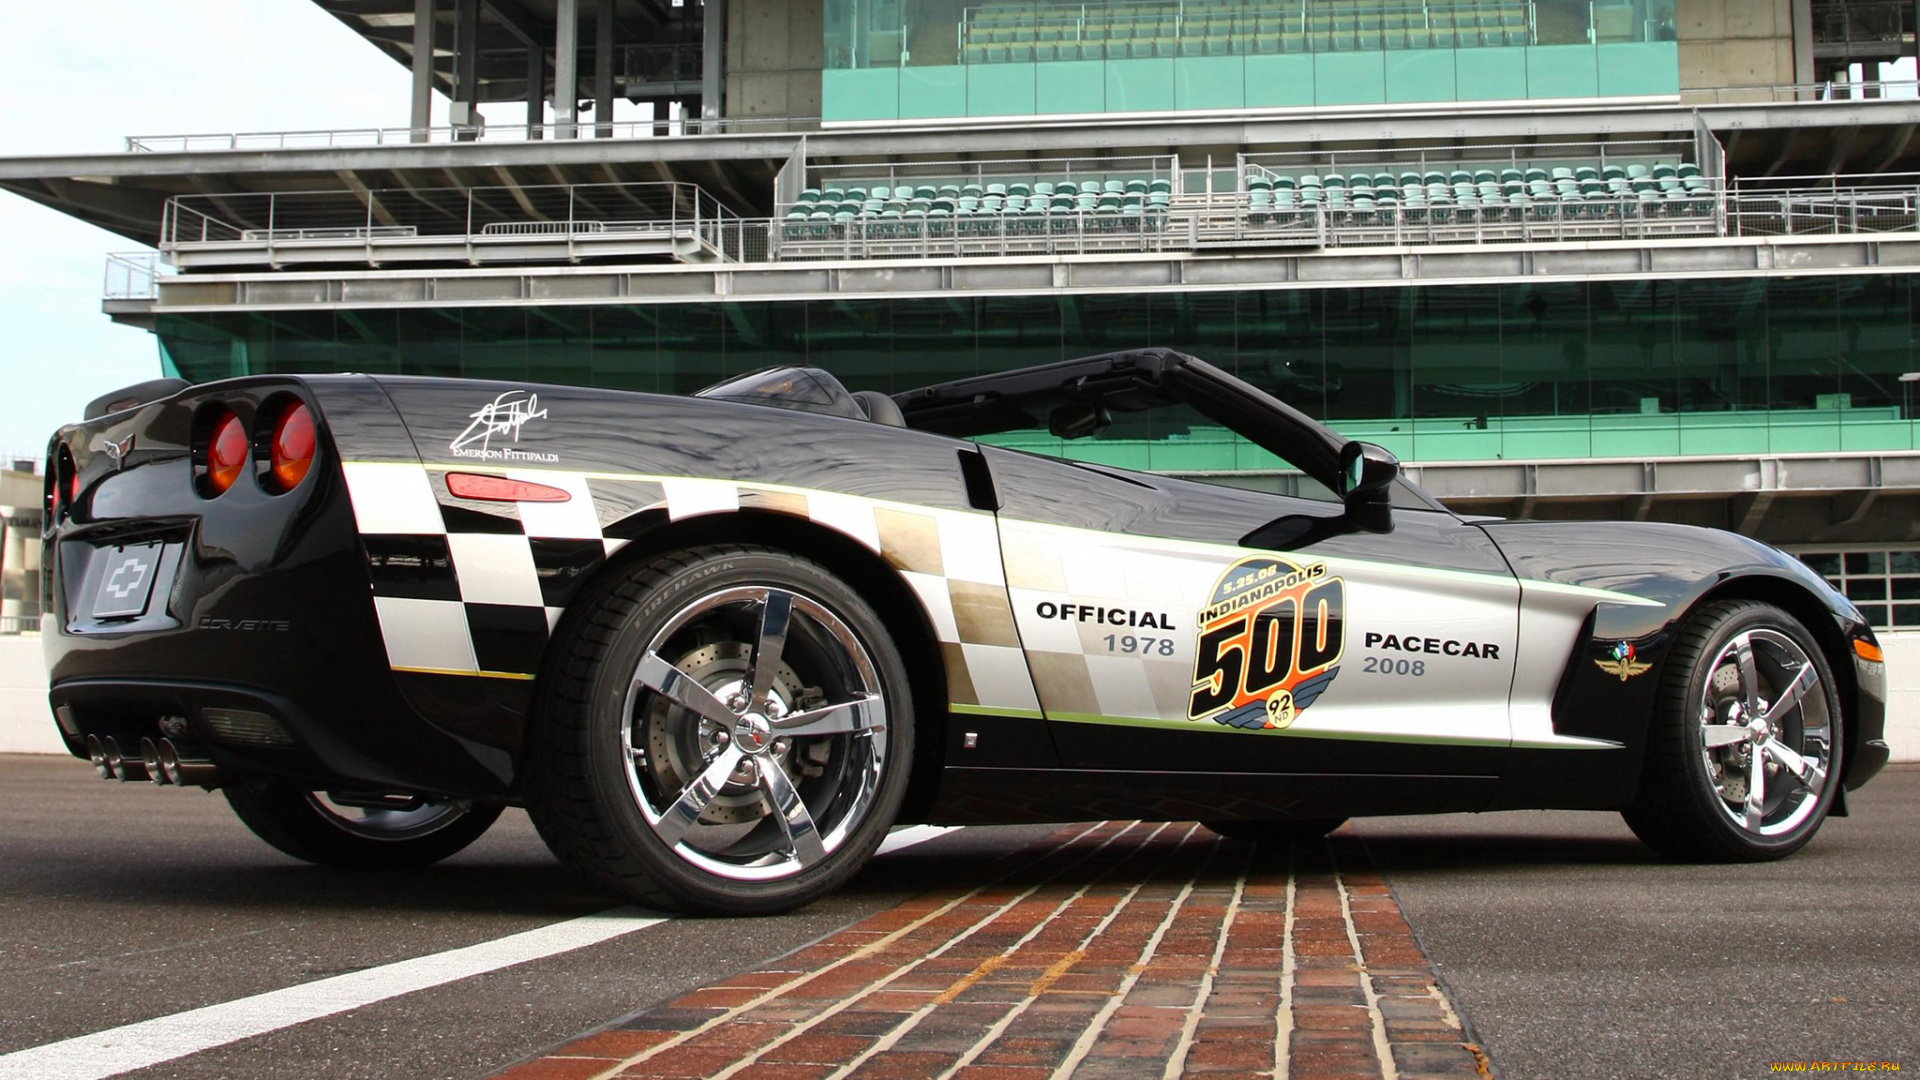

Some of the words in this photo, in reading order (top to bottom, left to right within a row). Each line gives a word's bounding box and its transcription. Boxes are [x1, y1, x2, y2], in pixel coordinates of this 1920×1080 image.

[453, 448, 502, 459] EMERSON
[503, 448, 559, 462] FITTIPALDI
[1222, 564, 1277, 595] 5.25.08
[633, 561, 735, 630] FIREHAWK
[1200, 563, 1324, 624] INDIANAPOLIS
[199, 615, 290, 631] CORVETTE
[1036, 601, 1176, 630] OFFICIAL
[1103, 634, 1175, 656] 1978
[1188, 577, 1344, 719] 500
[1365, 632, 1500, 660] PACECAR
[1363, 656, 1425, 676] 2008
[1268, 694, 1290, 716] 92
[1274, 711, 1289, 724] ND
